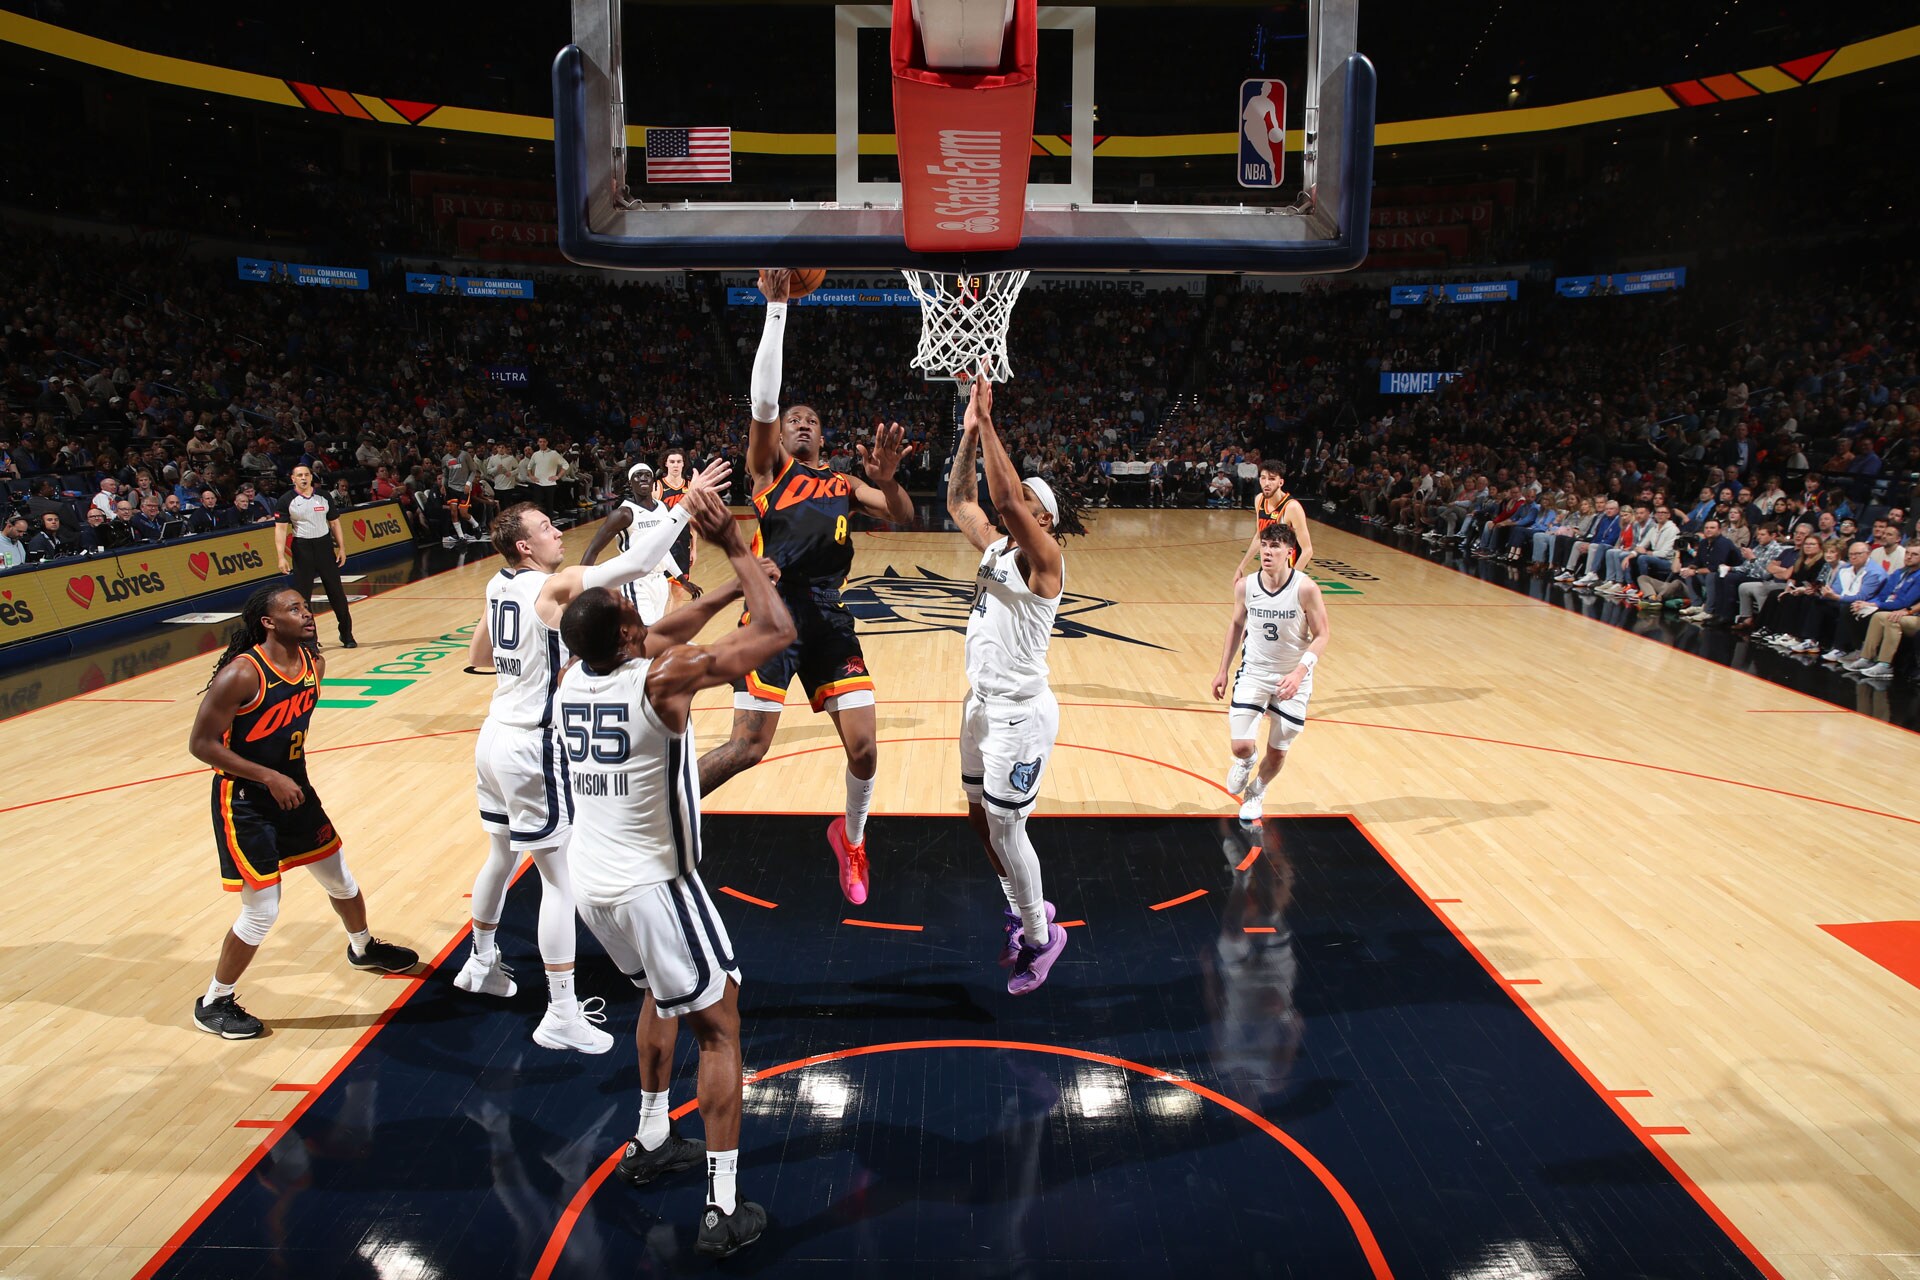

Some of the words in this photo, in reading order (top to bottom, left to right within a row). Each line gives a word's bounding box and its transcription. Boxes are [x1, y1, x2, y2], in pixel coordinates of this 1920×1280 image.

[1244, 163, 1266, 180] NBA
[1379, 206, 1486, 225] ERWIND
[490, 226, 557, 242] CASI
[1376, 231, 1435, 248] SINO
[299, 276, 330, 285] CLEANING
[317, 269, 357, 279] COMMERCIAL
[467, 287, 496, 295] CLEANING
[484, 281, 522, 289] COMMERCIAL
[1042, 280, 1144, 293] THUNDER
[1472, 284, 1508, 292] COMMERCIAL
[808, 293, 821, 302] The
[822, 294, 855, 302] Greatest
[883, 294, 892, 302] To
[894, 294, 910, 302] Ever
[1456, 293, 1483, 301] CLEANING
[491, 372, 527, 381] ULTRA
[775, 474, 847, 510] OKC
[834, 515, 847, 545] 8
[1250, 607, 1296, 619] MEMPHIS
[491, 599, 520, 650] 10
[1263, 623, 1279, 641] 3
[494, 656, 521, 677] ENNARD
[245, 687, 315, 742] OKC
[561, 703, 631, 764] 55
[573, 771, 608, 796] EMISON
[614, 773, 629, 796] III
